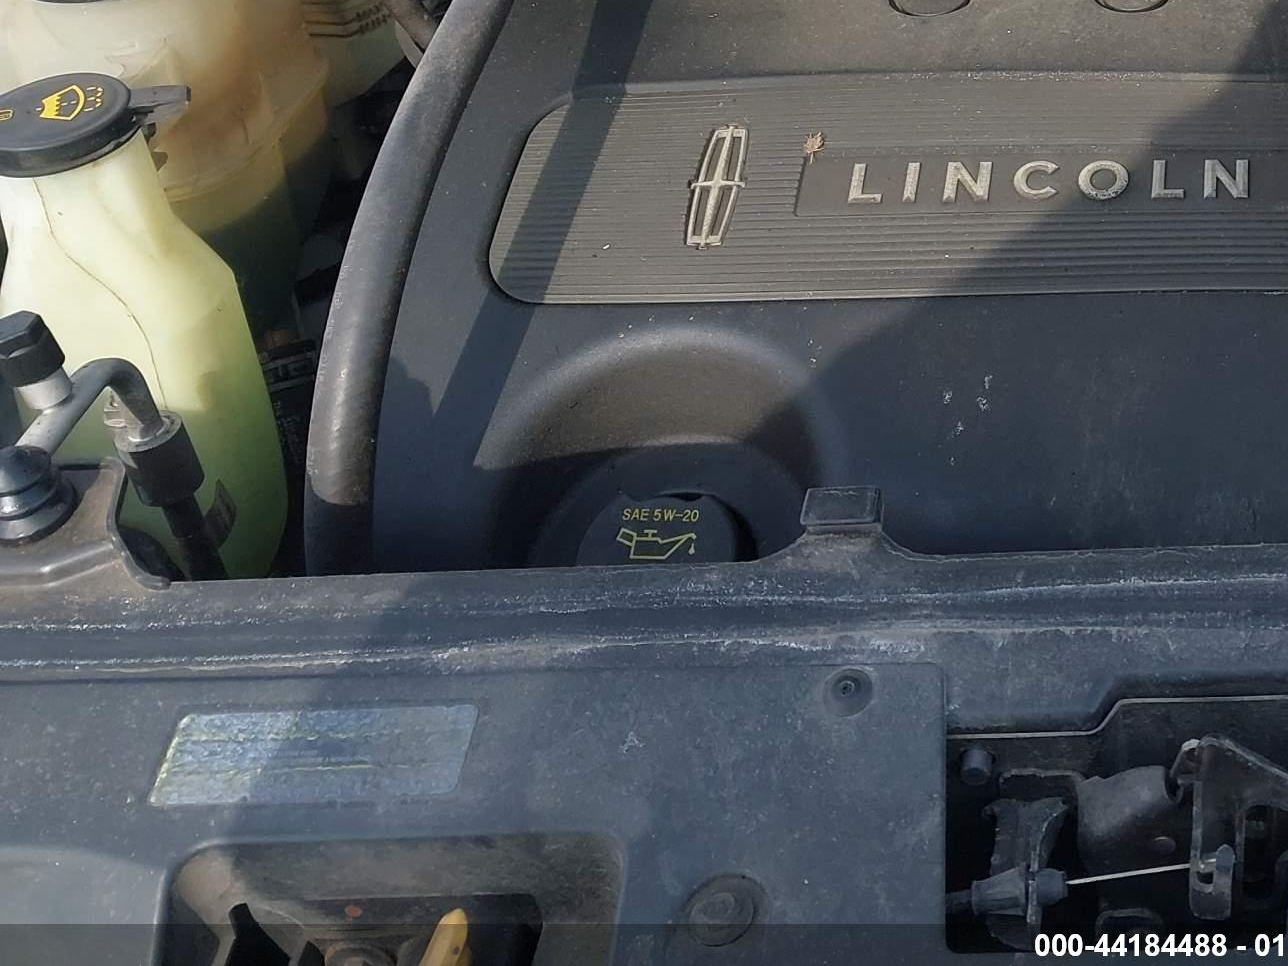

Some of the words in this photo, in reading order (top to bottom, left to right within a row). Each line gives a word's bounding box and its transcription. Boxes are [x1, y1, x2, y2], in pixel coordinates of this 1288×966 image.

[848, 158, 1250, 204] LINCOLN
[622, 508, 650, 521] SAE
[652, 508, 700, 522] 5W-20
